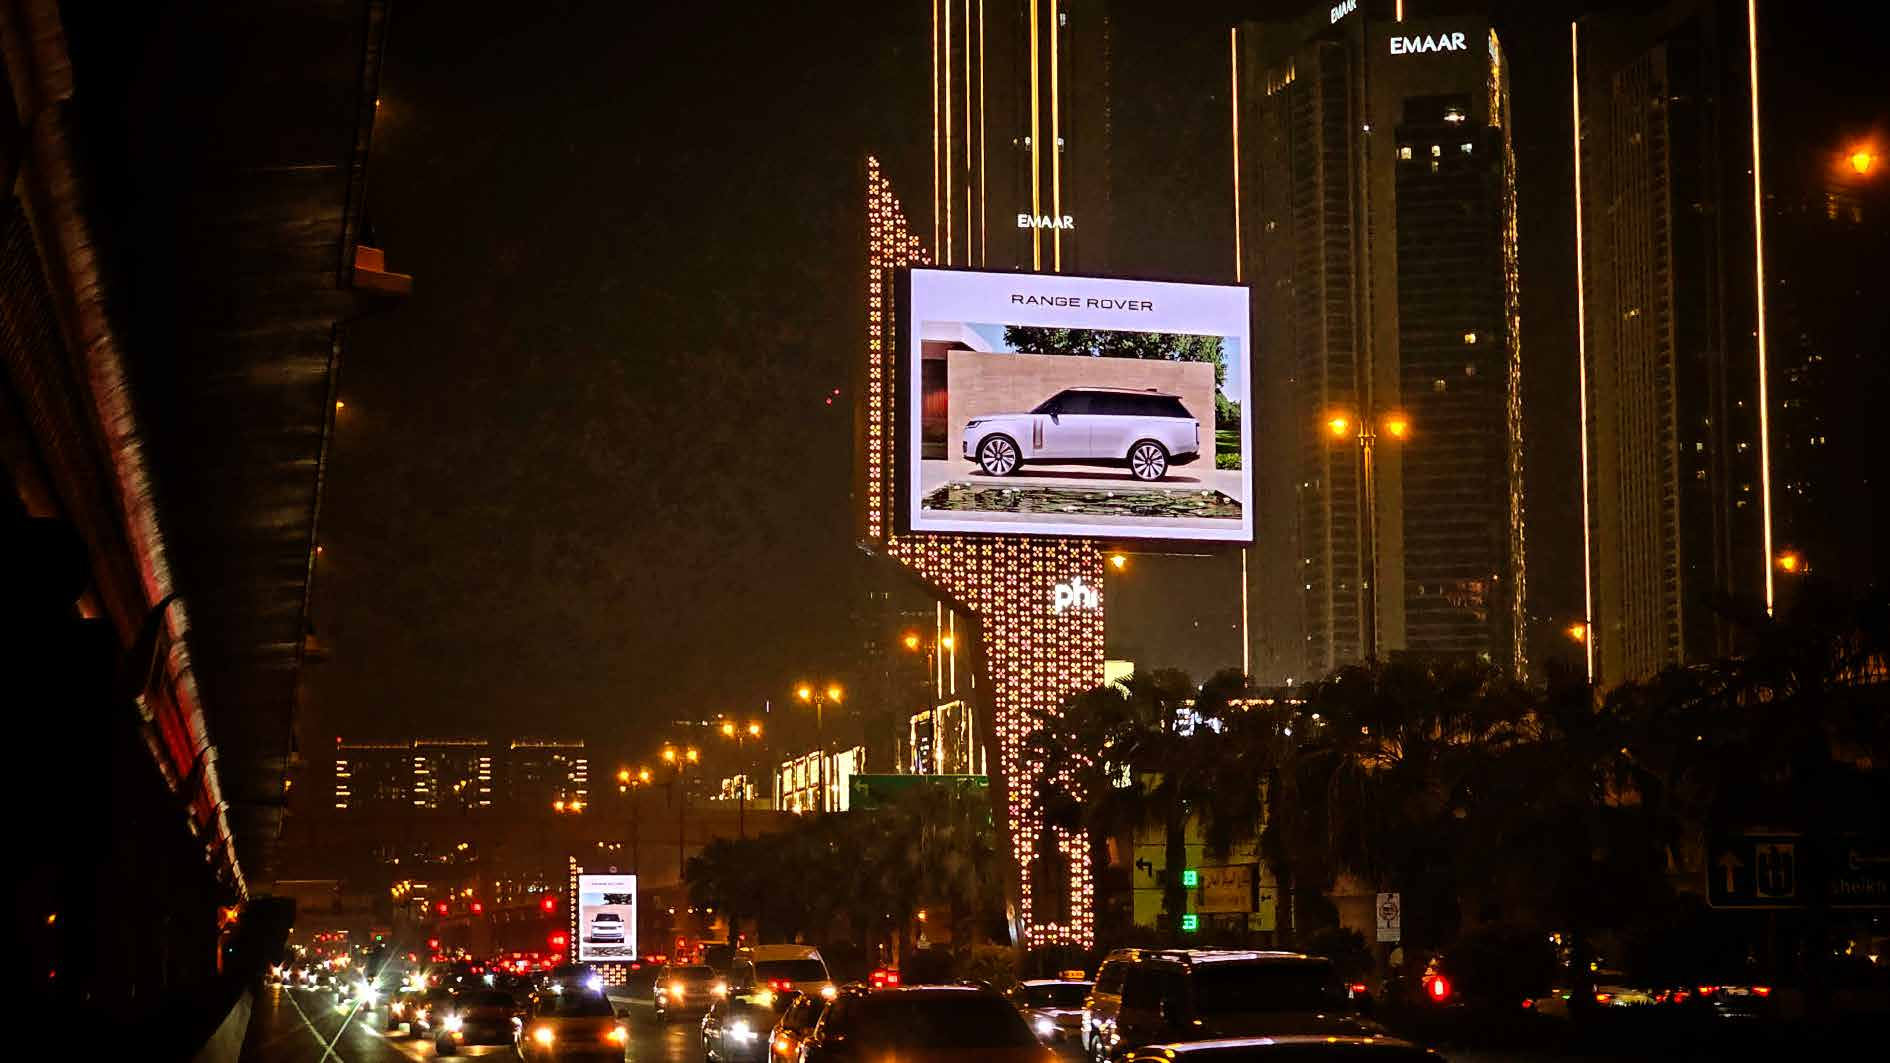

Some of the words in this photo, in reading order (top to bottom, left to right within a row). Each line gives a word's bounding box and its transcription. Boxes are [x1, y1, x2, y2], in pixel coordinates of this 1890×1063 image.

[1330, 0, 1357, 24] EMAAR
[1390, 32, 1467, 55] EMAAR
[1017, 214, 1074, 229] EMAAR
[1011, 294, 1081, 308] RANGE
[1086, 298, 1153, 312] ROVER
